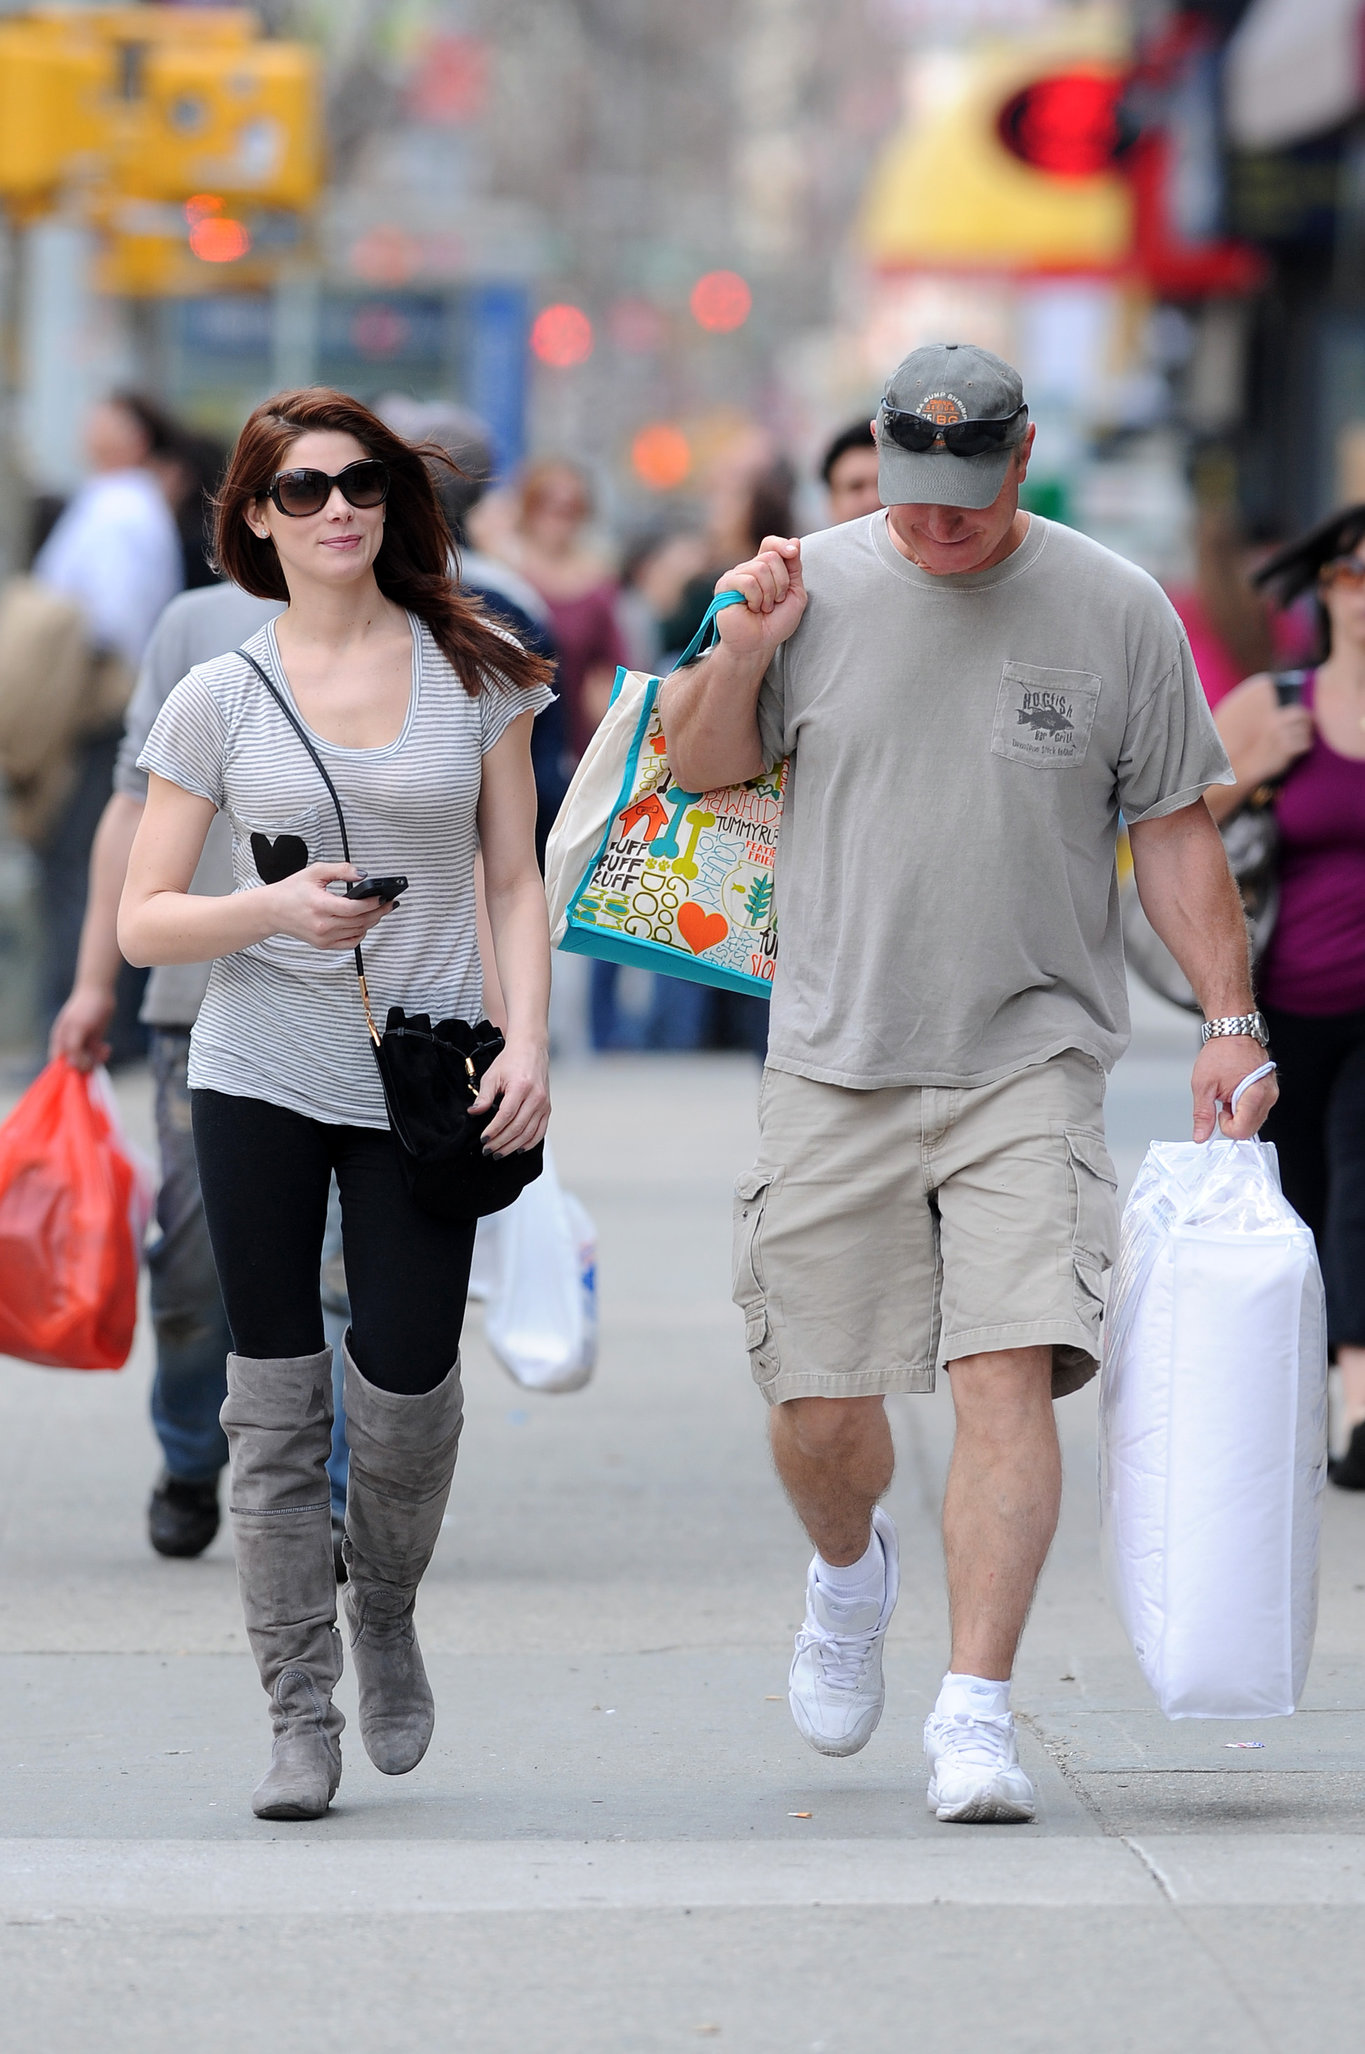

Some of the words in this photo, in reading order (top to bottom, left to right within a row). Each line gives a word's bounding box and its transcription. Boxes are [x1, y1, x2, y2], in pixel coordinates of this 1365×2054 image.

[923, 391, 946, 403] GUMP
[947, 393, 968, 420] SHRIMP
[694, 830, 719, 862] TOY
[597, 854, 645, 873] RUFF
[691, 832, 746, 912] SQUEAKY
[590, 870, 640, 892] RUFF
[623, 871, 667, 939] DOG
